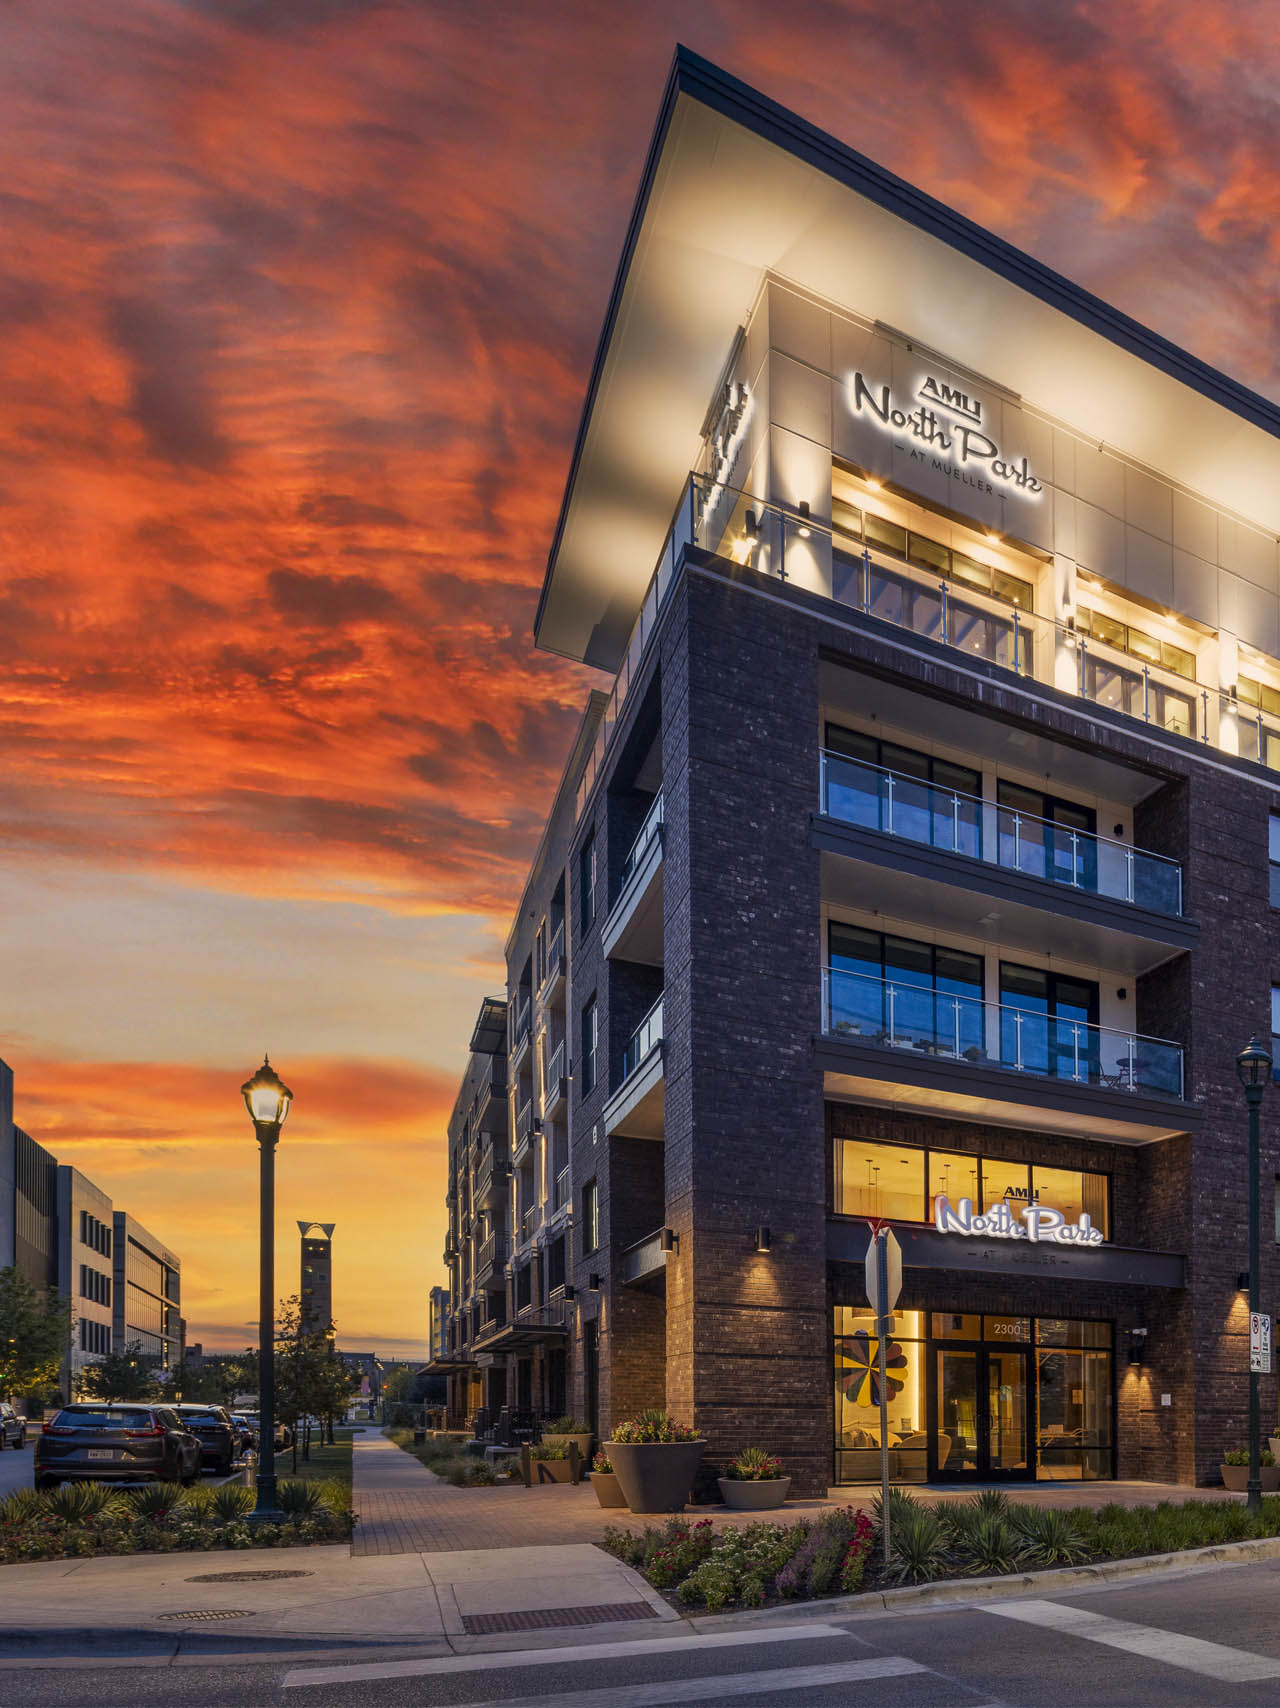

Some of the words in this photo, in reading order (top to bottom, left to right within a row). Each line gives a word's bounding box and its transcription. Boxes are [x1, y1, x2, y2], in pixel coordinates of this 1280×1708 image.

[921, 377, 981, 418] AMLI
[855, 372, 951, 449] North
[954, 425, 1042, 492] Park
[910, 449, 925, 463] AT
[932, 459, 993, 494] MUELLER
[936, 1195, 1025, 1239] North
[1022, 1202, 1103, 1246] Park
[994, 1324, 1021, 1334] 2300
